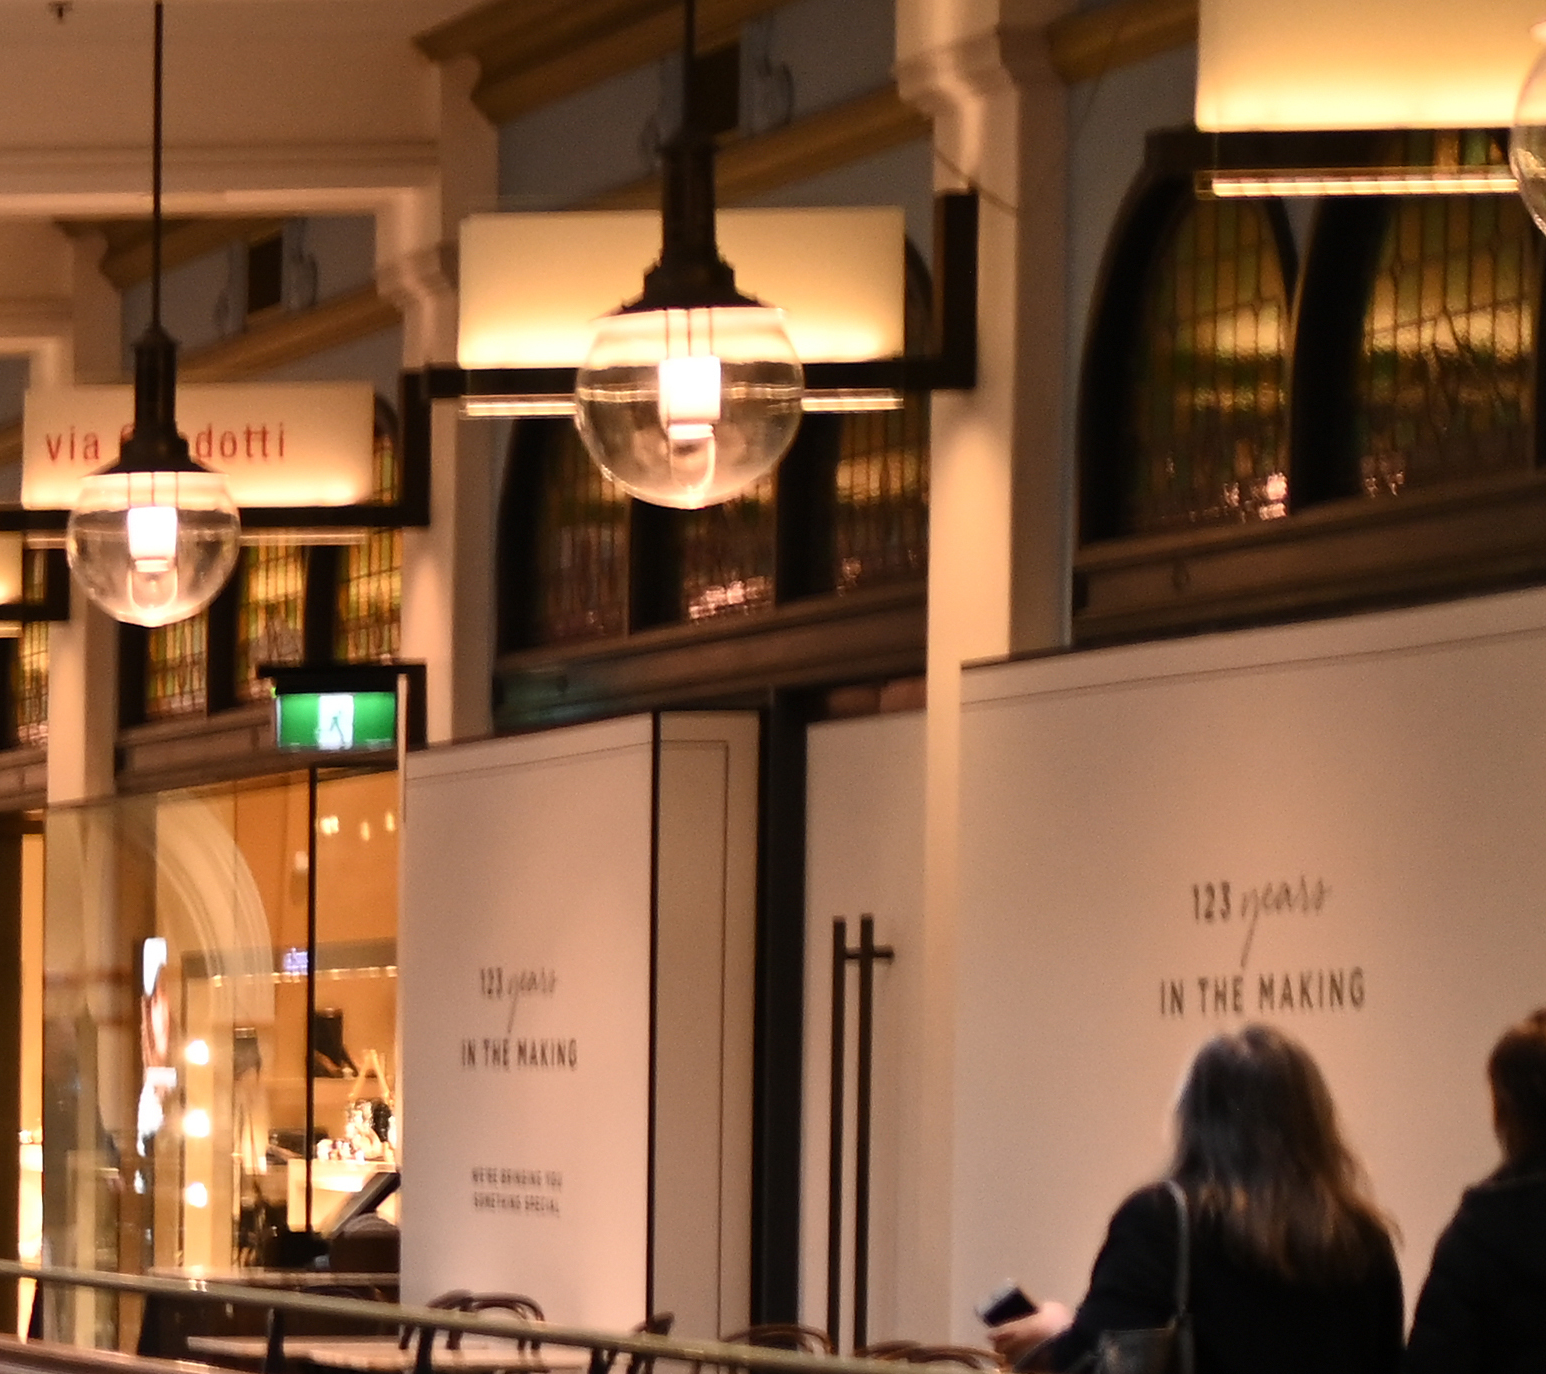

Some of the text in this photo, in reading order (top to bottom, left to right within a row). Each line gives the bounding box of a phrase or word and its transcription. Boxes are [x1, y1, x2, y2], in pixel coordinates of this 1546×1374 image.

[46, 421, 285, 461] via dotti
[1193, 875, 1333, 969] 123 years
[480, 967, 504, 996] 123
[1160, 966, 1366, 1014] IN THE MAKING
[462, 1038, 577, 1070] IN THE MAKING
